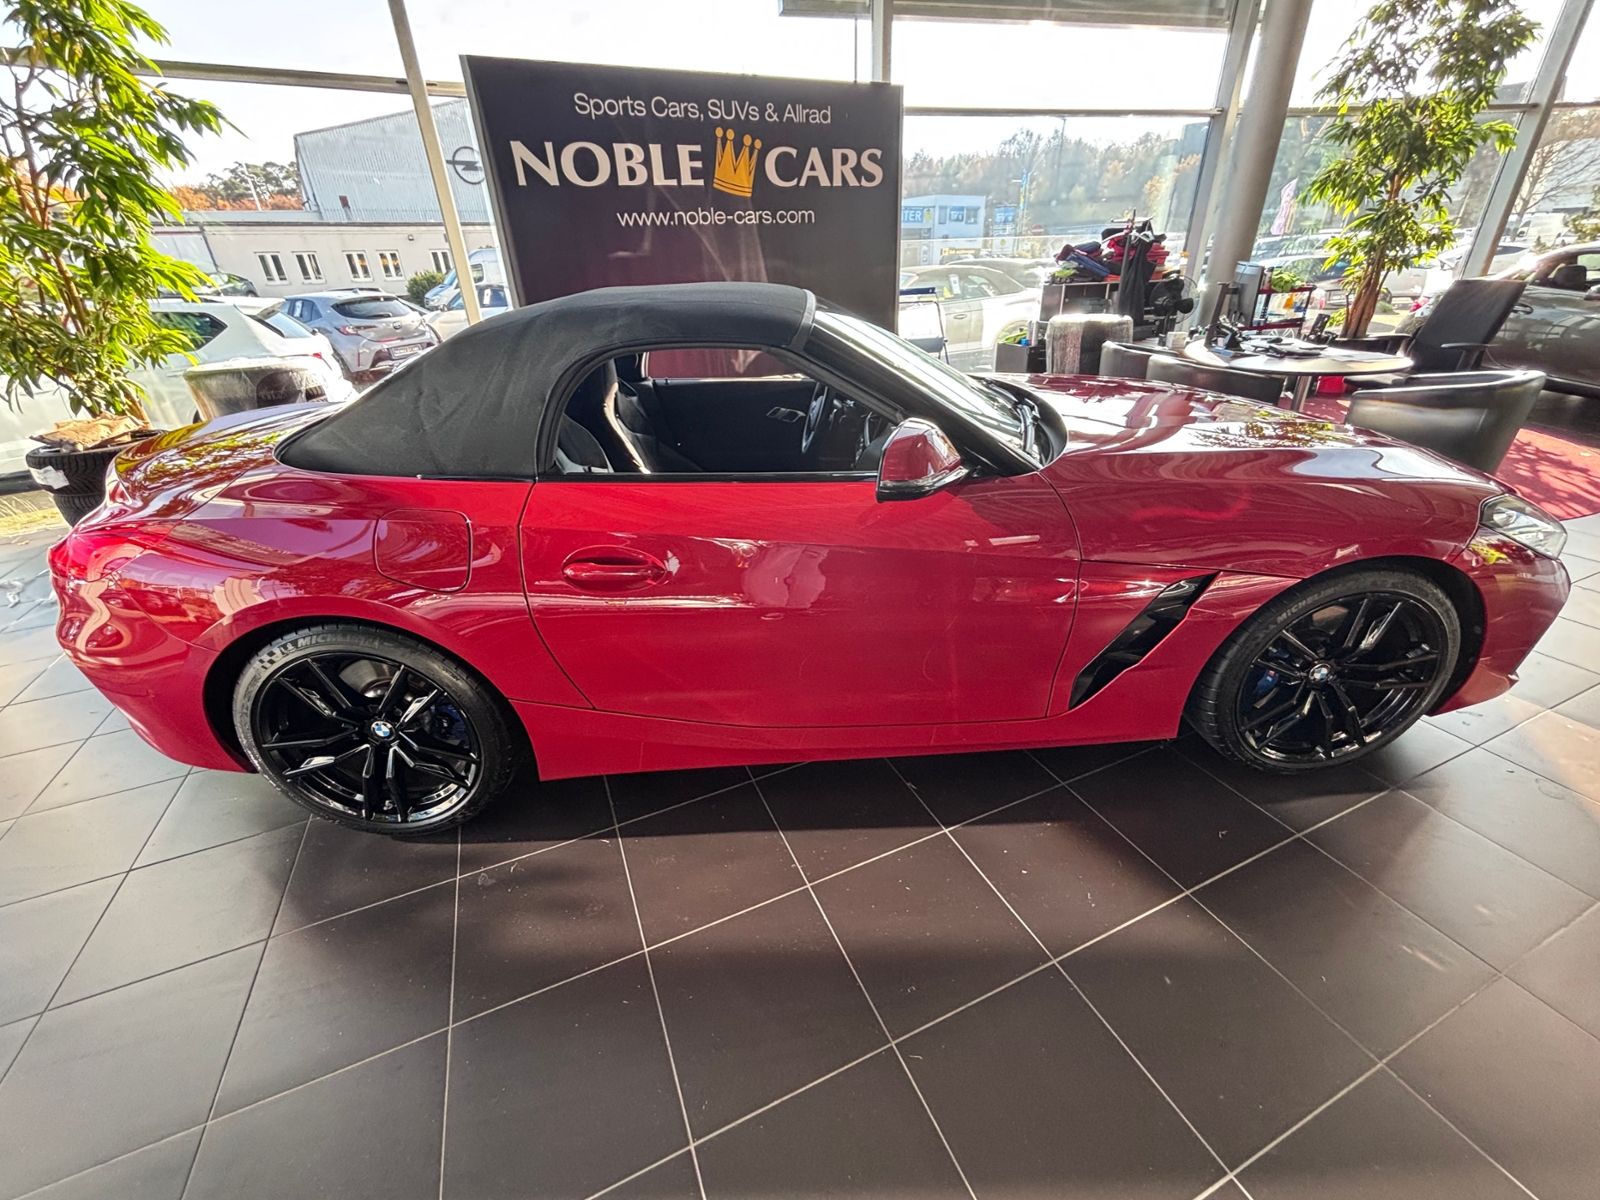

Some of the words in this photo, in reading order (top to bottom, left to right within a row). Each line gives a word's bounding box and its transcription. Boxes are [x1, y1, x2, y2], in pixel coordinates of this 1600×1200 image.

[574, 92, 646, 119] Sports
[651, 96, 704, 121] Cars,
[708, 99, 760, 121] SUVs
[765, 102, 779, 122] &
[783, 103, 831, 124] Allrad
[510, 140, 705, 187] NOBLE
[765, 146, 884, 187] CARS
[616, 207, 815, 227] www.noble-cars.com
